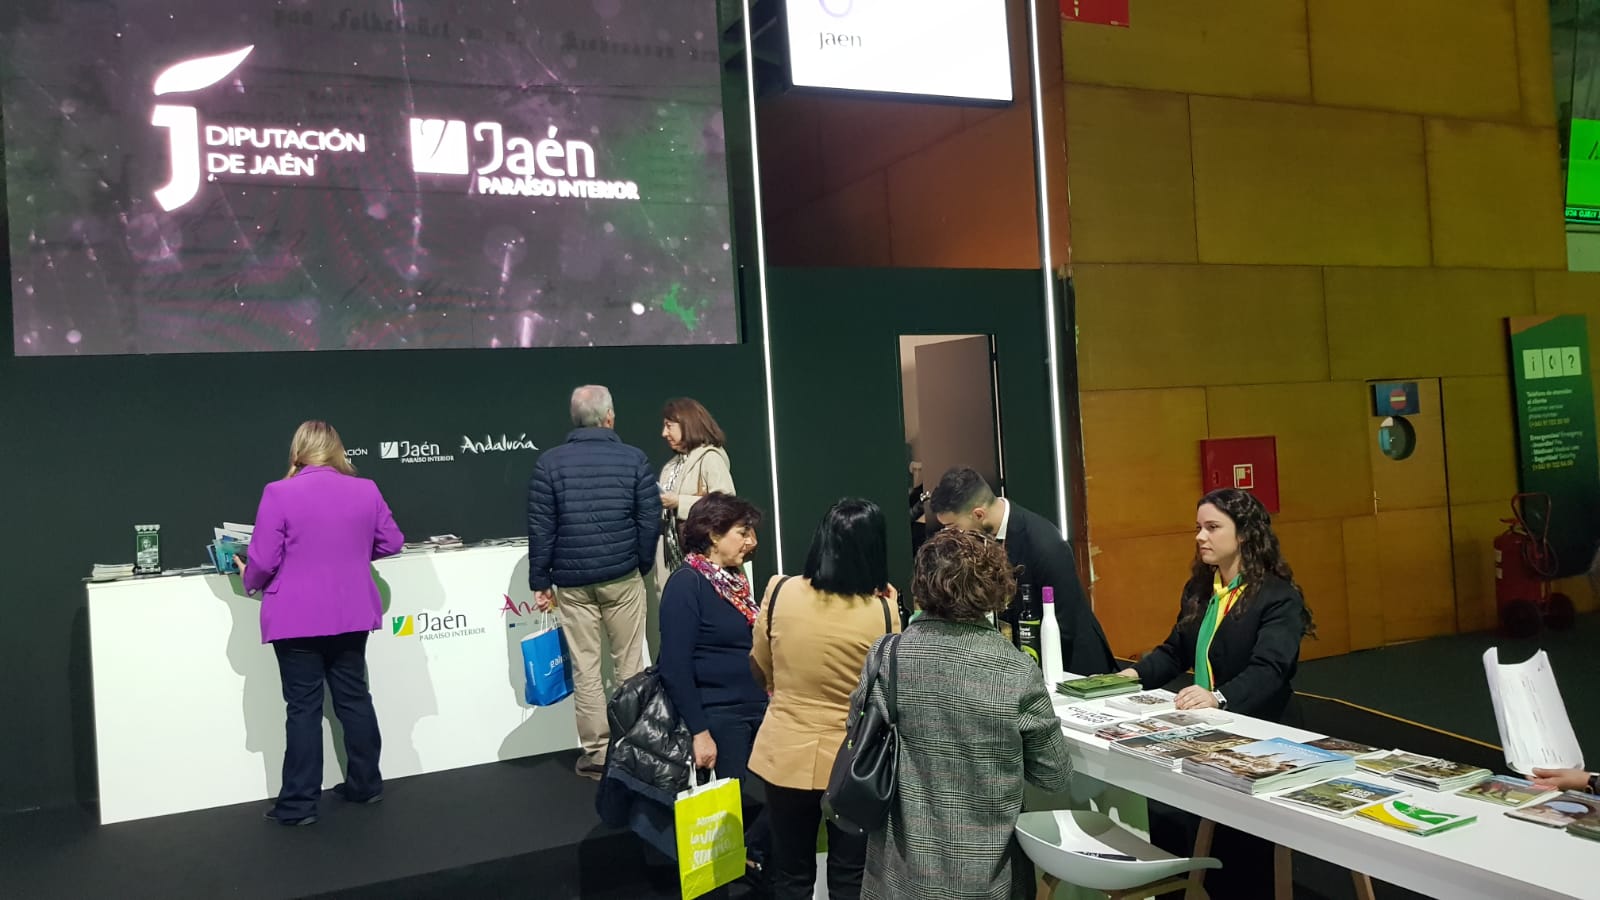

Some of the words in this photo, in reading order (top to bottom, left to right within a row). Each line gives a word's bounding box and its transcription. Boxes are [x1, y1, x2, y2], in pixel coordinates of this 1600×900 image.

[205, 124, 366, 153] DIPUTACIÓN
[472, 124, 596, 178] Jaén
[207, 153, 246, 174] DE
[249, 152, 315, 177] JAÉN
[478, 175, 557, 197] PARAÍSO
[557, 180, 641, 200] INTERIOR
[401, 440, 440, 457] Jaén
[460, 433, 540, 454] Andalucía
[417, 609, 467, 634] Jaén
[419, 632, 451, 641] PARAÍSO
[452, 627, 486, 638] INTERIOR
